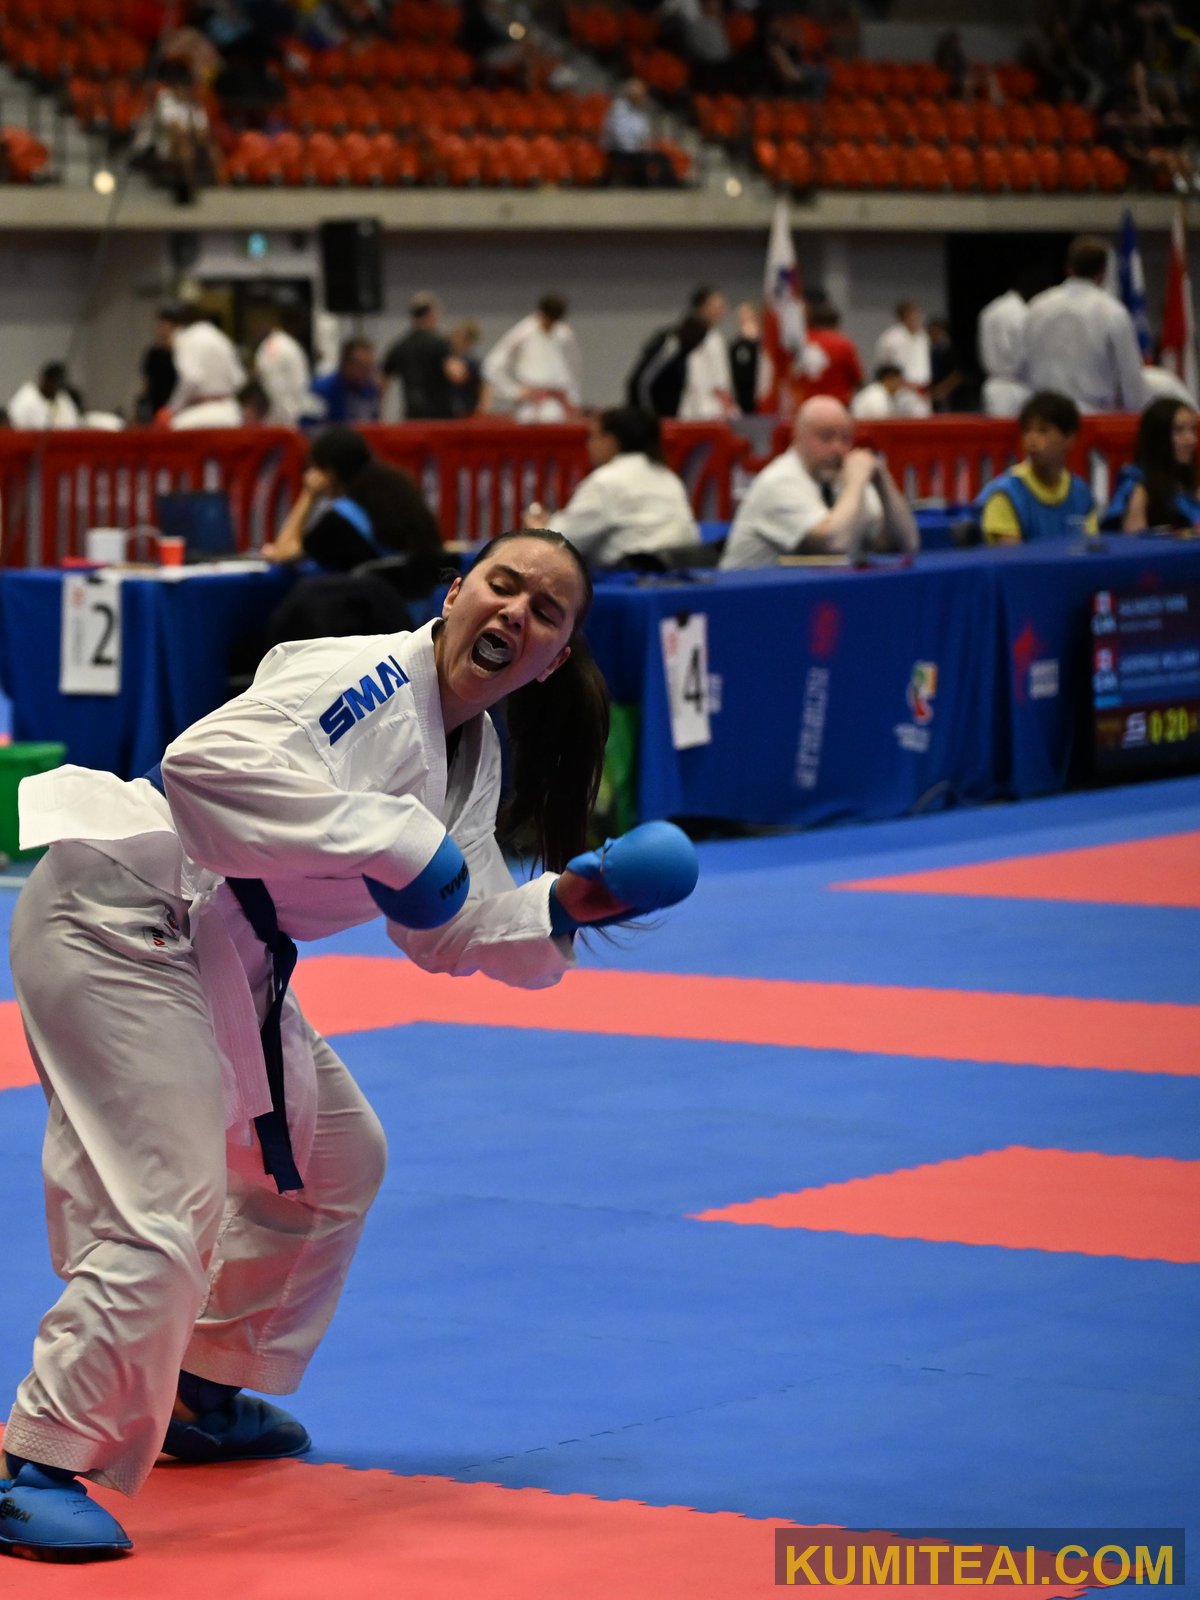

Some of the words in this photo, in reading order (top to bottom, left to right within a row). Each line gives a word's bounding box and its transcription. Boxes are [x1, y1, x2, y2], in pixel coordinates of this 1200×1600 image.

[92, 603, 113, 667] 2
[319, 655, 410, 747] SMAI
[683, 645, 704, 714] 4
